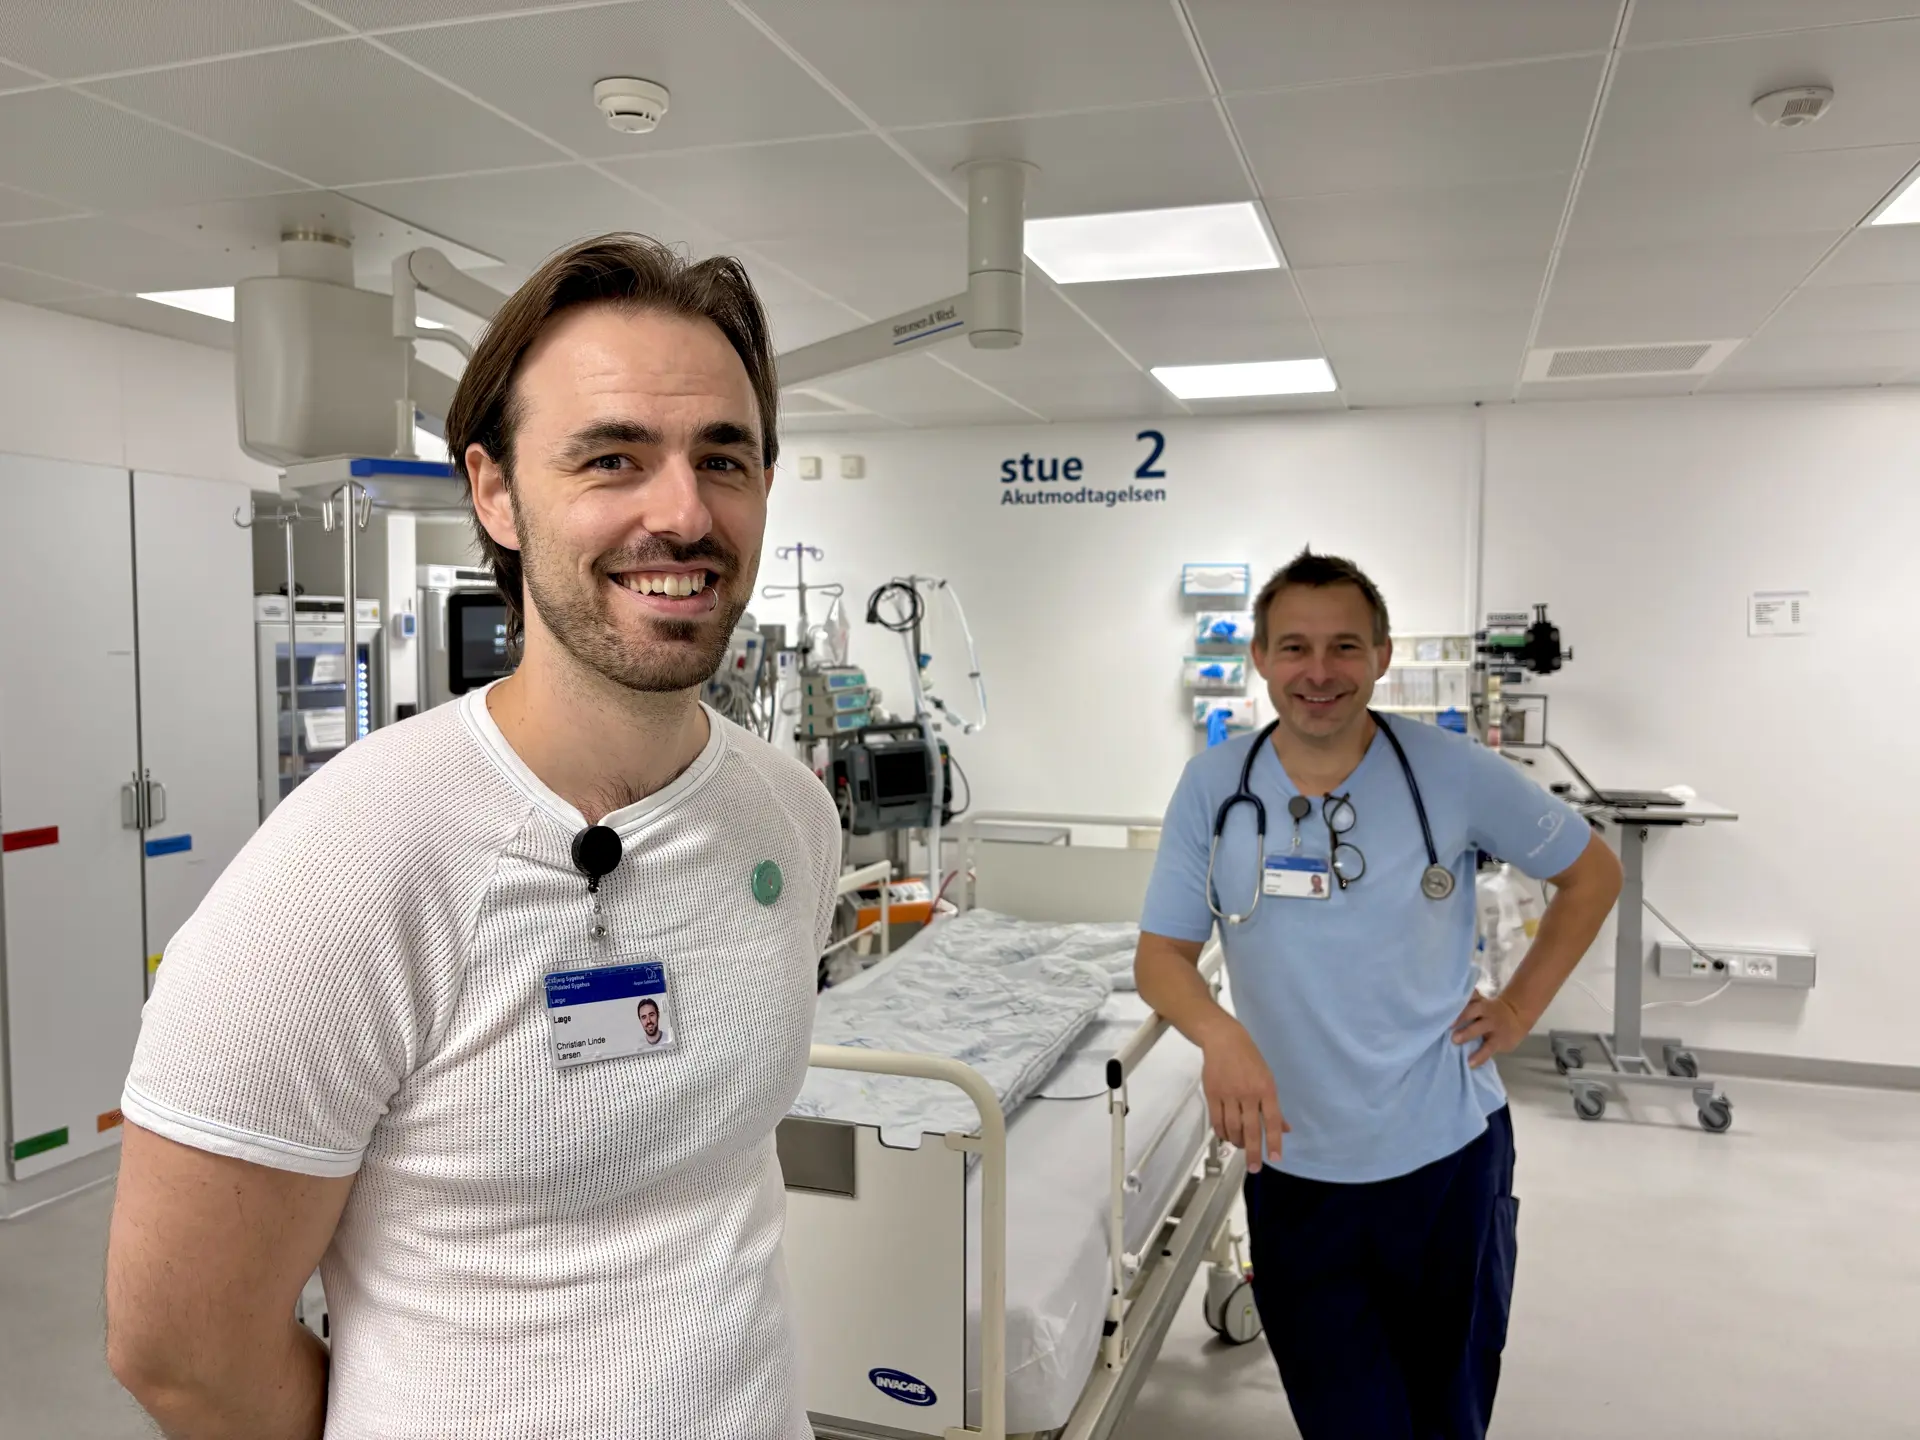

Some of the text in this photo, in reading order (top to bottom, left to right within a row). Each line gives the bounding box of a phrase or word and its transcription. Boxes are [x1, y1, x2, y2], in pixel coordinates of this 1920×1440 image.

[1000, 429, 1167, 483] stue 2
[1000, 485, 1166, 508] Akutmodtagelsen
[553, 1014, 572, 1024] Læge
[556, 1036, 606, 1051] Christian Linde
[557, 1050, 581, 1061] Larsen
[876, 1376, 926, 1395] INVACARE
